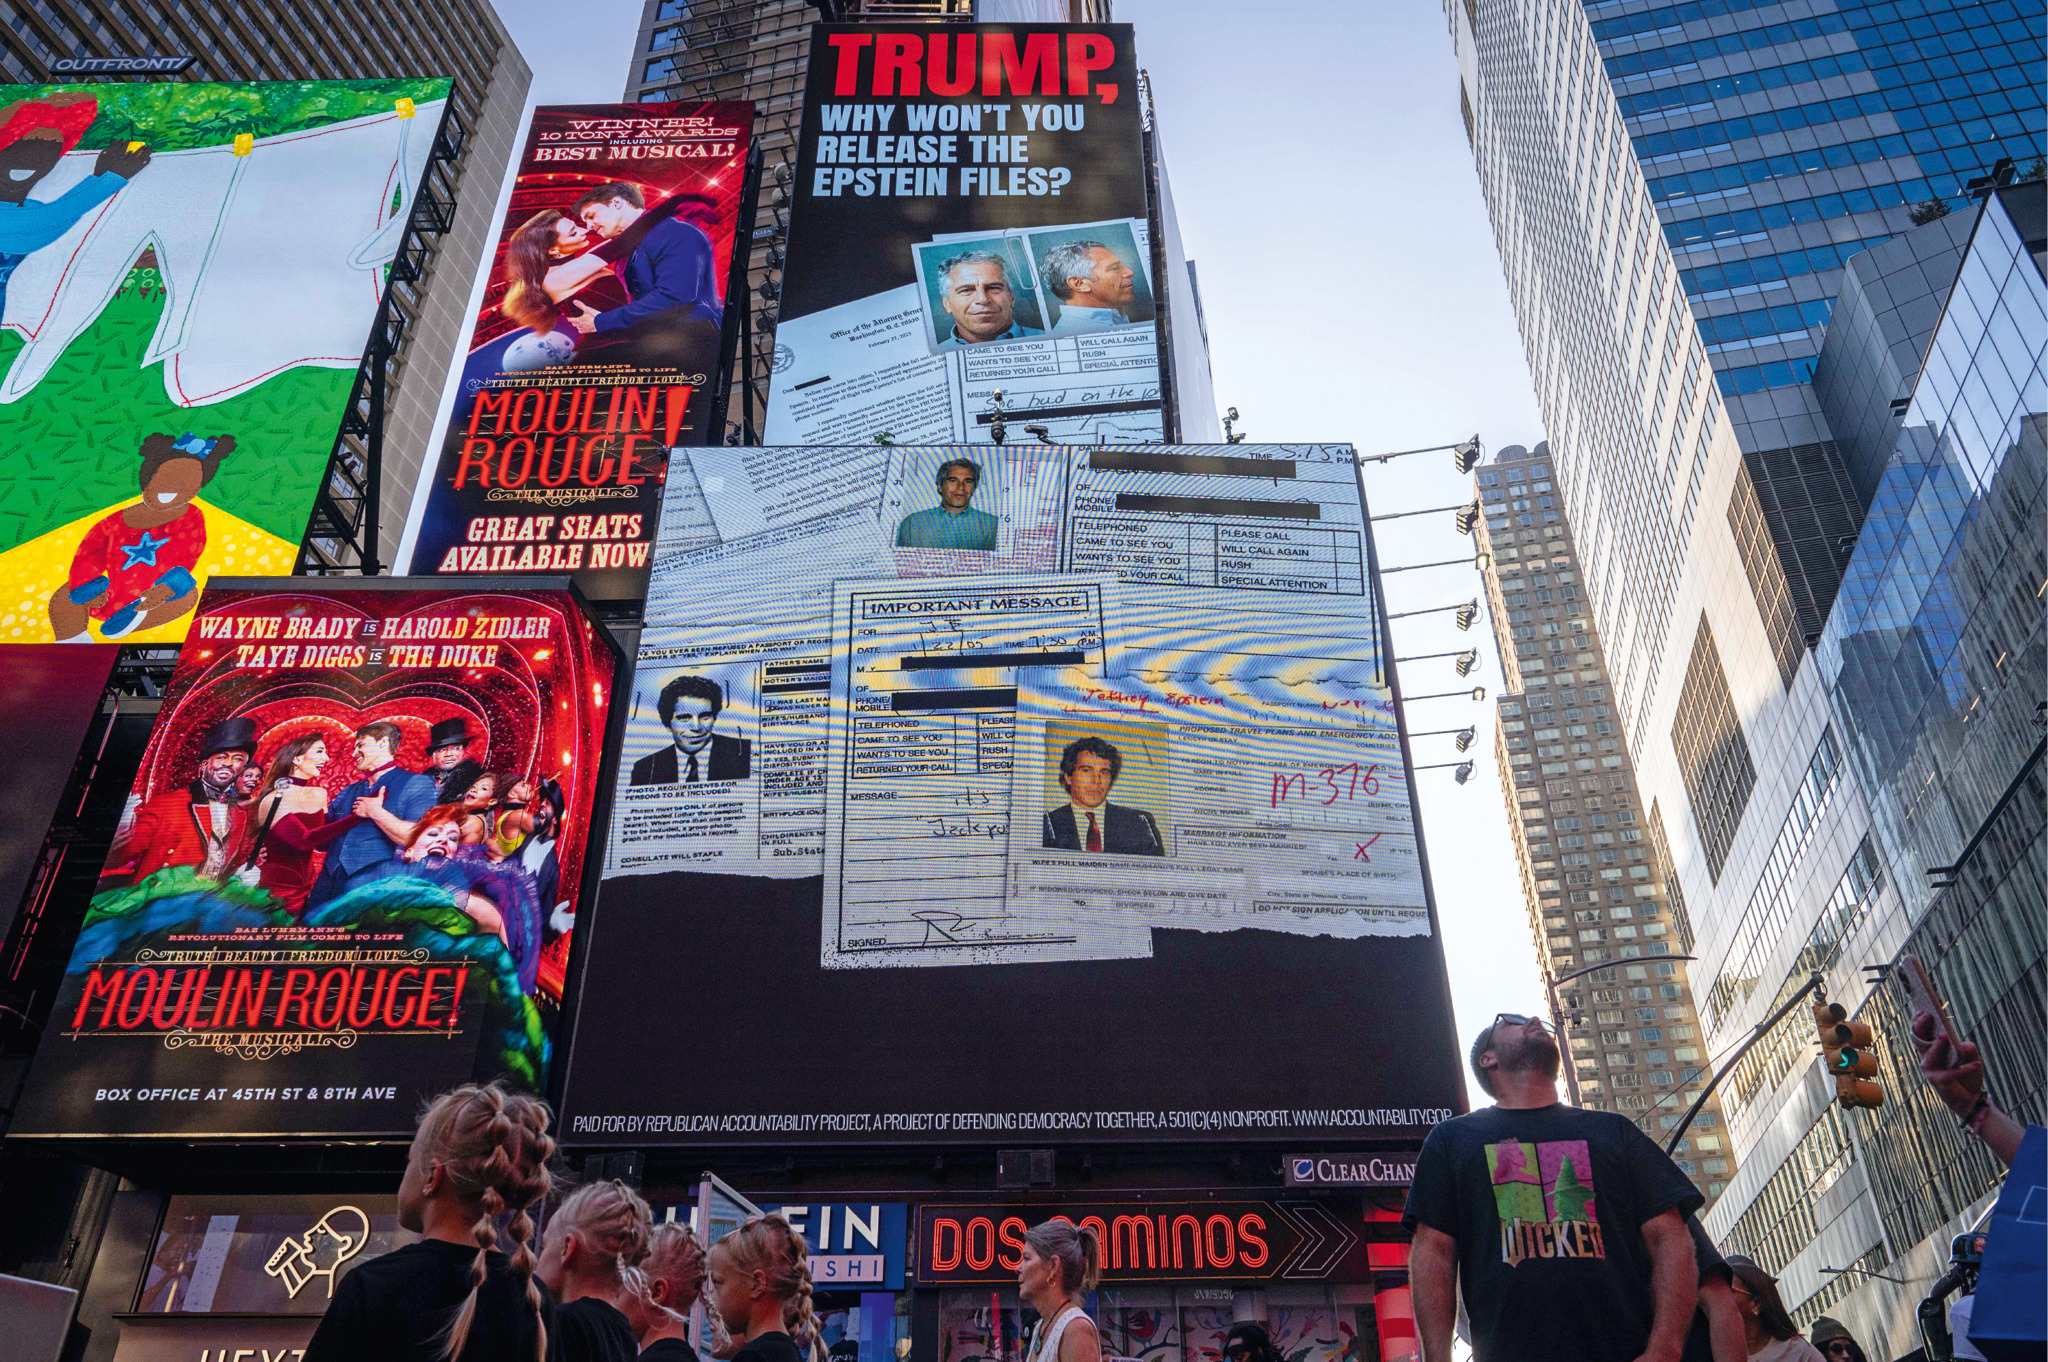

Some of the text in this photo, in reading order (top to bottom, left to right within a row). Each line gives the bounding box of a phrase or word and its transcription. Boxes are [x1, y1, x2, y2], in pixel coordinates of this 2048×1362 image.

[828, 33, 1119, 104] TRUMP,
[568, 117, 714, 130] WINNER!
[821, 104, 1085, 131] WHY WON'T YOU
[540, 128, 740, 140] 10 TONY AWARDS
[534, 143, 735, 161] BEST MUSICAL!
[816, 135, 1028, 163] RELEASE THE
[812, 167, 1072, 196] EPSTEIN FILES?
[1123, 335, 1149, 343] AGAIN
[968, 358, 998, 367] WANTS
[1084, 361, 1118, 369] SPECIAL
[969, 369, 1011, 378] RETURNED
[1012, 367, 1036, 375] YOUR
[538, 378, 581, 386] BEAUTY
[592, 376, 643, 385] FREEDOM
[654, 375, 684, 384] LOVE
[514, 488, 611, 498] THE MUSICAL!
[468, 515, 642, 542] GREAT SEATS
[1078, 523, 1147, 532] TELEPHONED
[1221, 530, 1291, 540] PLEASE CALL
[1076, 538, 1107, 546] CAME
[1127, 540, 1149, 548] SEE
[1152, 541, 1173, 549] YOU
[439, 543, 583, 572] AVAILABLE
[589, 542, 651, 568] NOW
[1221, 545, 1309, 557] WILL CALL AGAIN
[1075, 553, 1113, 562] WANTS
[1133, 556, 1155, 564] SEE
[1157, 557, 1181, 565] YOU
[1222, 561, 1251, 569] RUSH
[1129, 571, 1184, 582] YOUR CALL
[1221, 576, 1328, 590] SPECIAL ATTENTION
[871, 596, 1082, 614] IMPORTANT MESSAGE
[199, 617, 282, 639] WAYNE
[283, 617, 362, 639] BRADY
[380, 617, 469, 639] HAROLD
[471, 617, 551, 639] ZIDLER
[235, 645, 298, 667] TAYE
[300, 645, 365, 667] DIGGS
[389, 645, 433, 667] THE
[436, 645, 499, 667] DUKE
[855, 704, 889, 712] MOBILE
[858, 720, 919, 729] TELEPHONED
[858, 736, 885, 744] CAME
[923, 734, 942, 742] YOU
[857, 751, 890, 759] WANTS
[909, 749, 928, 757] SEE
[929, 748, 949, 756] YOU
[856, 763, 953, 774] RETURNED YOUR CALL
[851, 792, 898, 801] MESSAGE
[848, 938, 887, 947] SIGNED
[166, 951, 401, 963] TRUTH BEAUTY FREEDOM LOVE
[72, 967, 470, 1029] MOULIN ROUGE!
[200, 1033, 323, 1046] THE MUSICAL!
[95, 1087, 397, 1101] BOX OFFICE AT 45TH ST & 8TH AVE
[573, 1115, 600, 1132] PAID
[602, 1115, 626, 1132] FOR
[627, 1115, 645, 1132] BY
[645, 1115, 719, 1132] REPUBLICAN
[720, 1115, 819, 1131] ACCOUNTABILITY
[820, 1114, 872, 1133] PROJECT,
[873, 1114, 882, 1130] A
[883, 1113, 934, 1130] PROJECT
[935, 1113, 951, 1130] OF
[952, 1113, 1017, 1130] DEFENDING
[1018, 1112, 1093, 1129] DEMOCRACY
[1095, 1111, 1158, 1129] TOGETHER,
[1158, 1111, 1168, 1127] A
[1169, 1111, 1222, 1130] 501(C)(4)
[1222, 1110, 1291, 1127] NONPROFIT.
[1317, 1158, 1369, 1182] CLEAR
[932, 1216, 1027, 1271] DOS
[1500, 1217, 1606, 1268] WICKED
